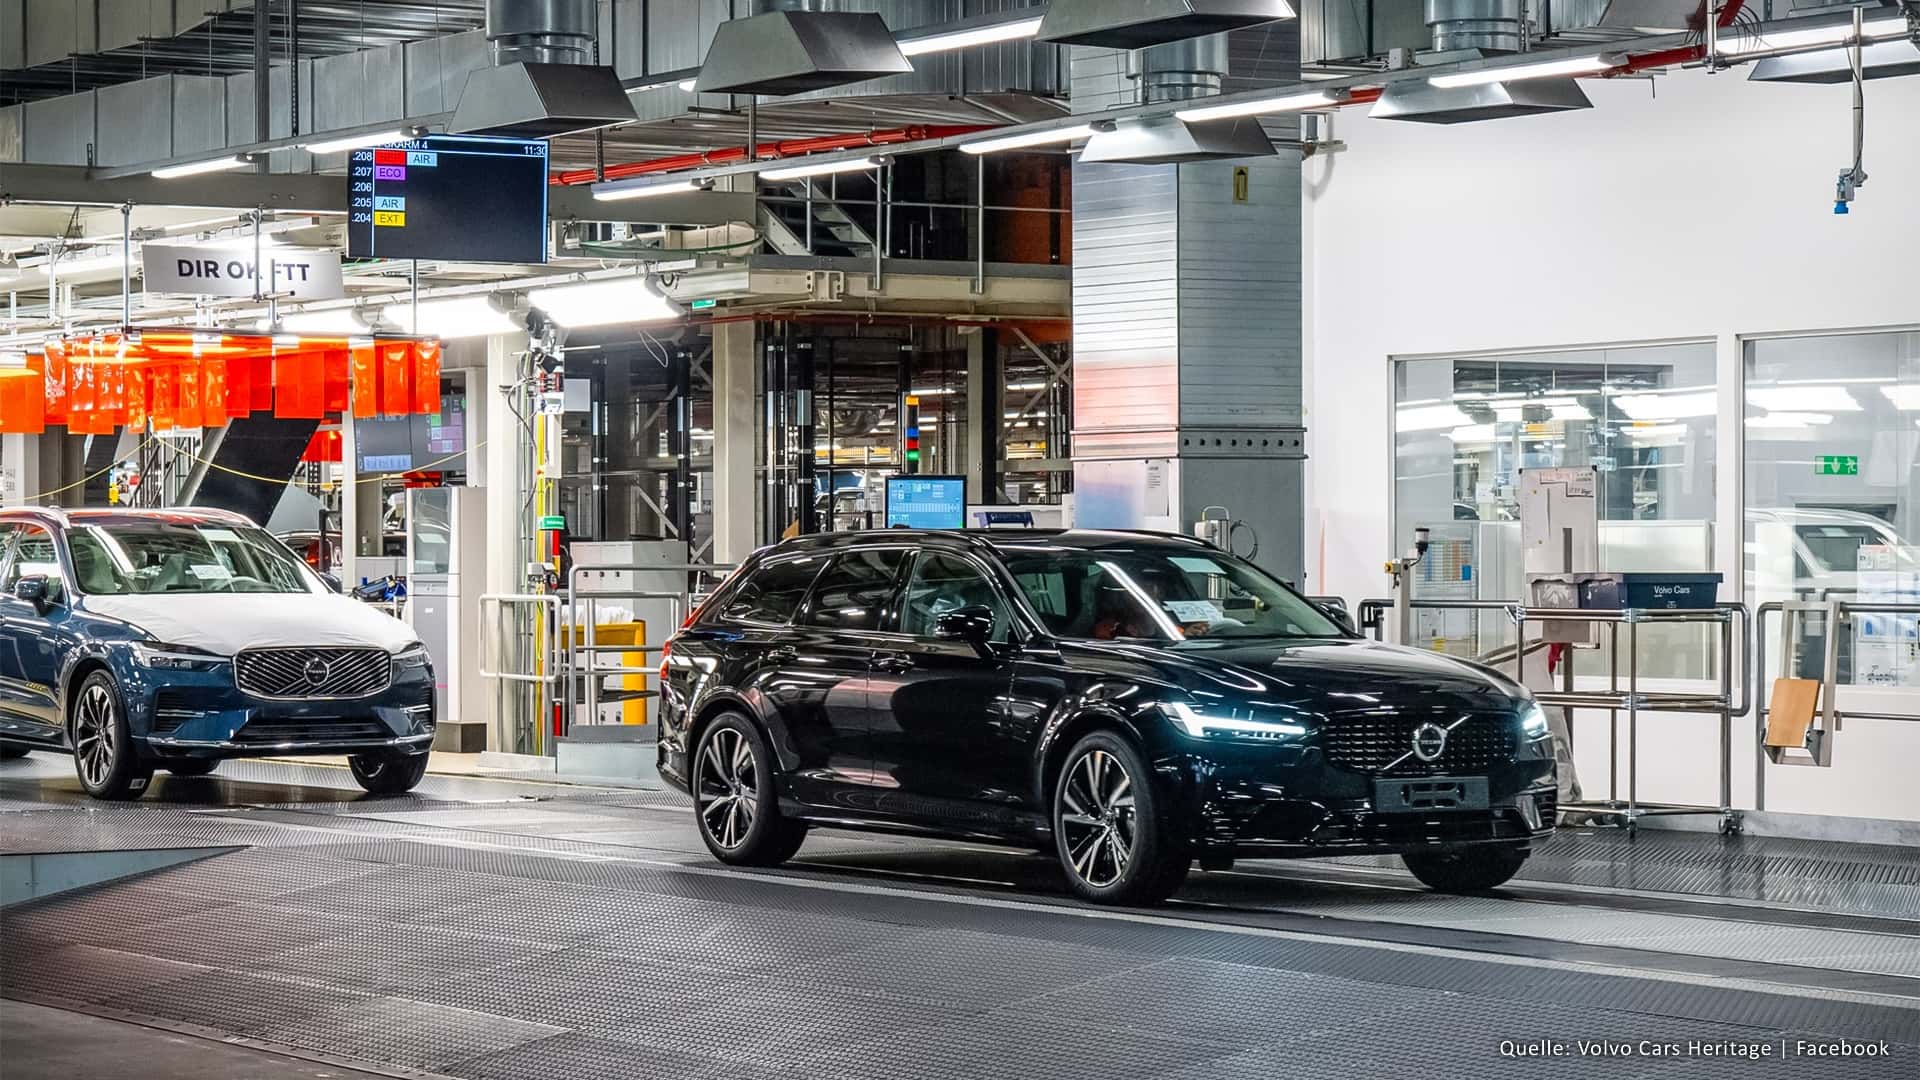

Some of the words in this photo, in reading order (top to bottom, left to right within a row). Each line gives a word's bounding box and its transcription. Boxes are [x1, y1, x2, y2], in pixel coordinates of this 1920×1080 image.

[422, 141, 429, 149] 4
[413, 154, 431, 164] AIR
[379, 168, 401, 178] ECO
[380, 200, 399, 209] AIR
[379, 215, 399, 224] EXT
[176, 259, 221, 279] DIR
[1654, 585, 1673, 594] Volvo
[1673, 585, 1691, 594] Cars
